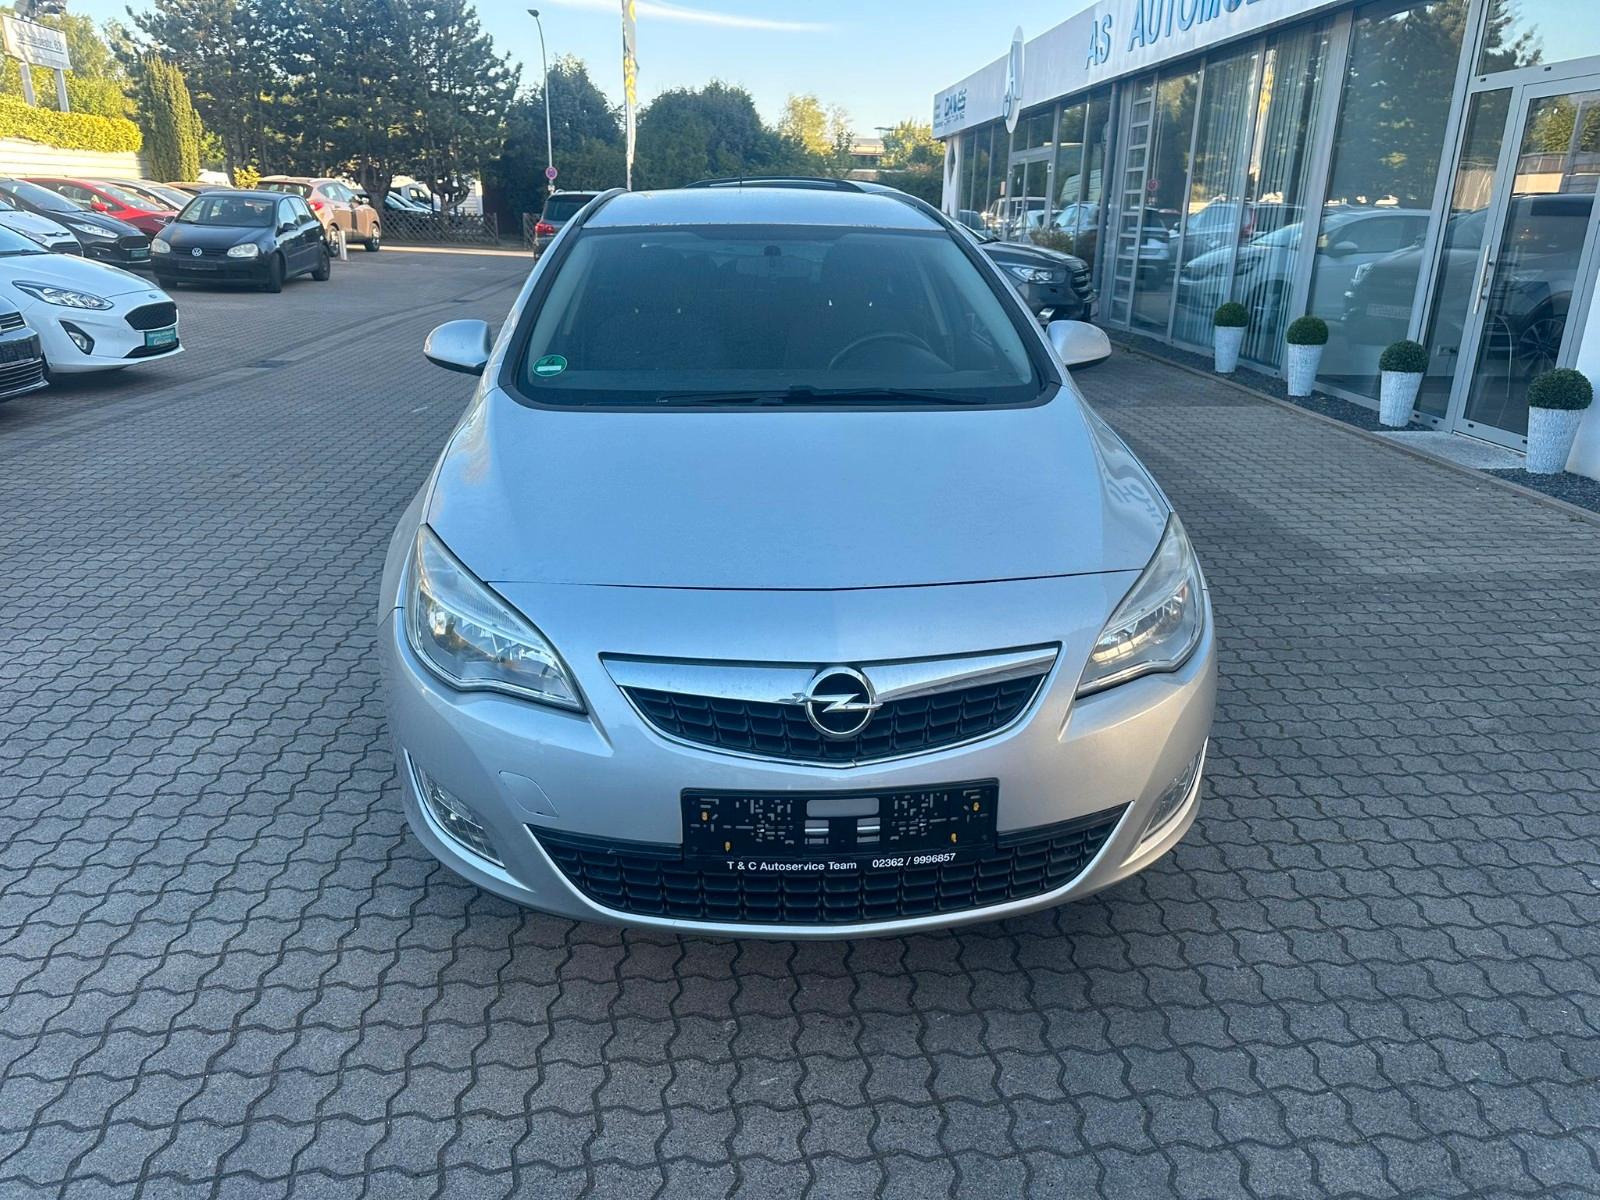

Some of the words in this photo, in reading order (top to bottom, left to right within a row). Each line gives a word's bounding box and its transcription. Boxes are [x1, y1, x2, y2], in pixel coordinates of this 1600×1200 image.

[1085, 13, 1112, 70] AS
[1127, 0, 1262, 52] AUTO
[727, 861, 735, 870] T
[737, 861, 746, 870] &
[748, 861, 757, 871] C
[759, 861, 825, 871] Autoservice
[828, 861, 857, 870] Team
[872, 857, 904, 868] 02362
[905, 856, 912, 866] /
[913, 852, 956, 865] 9996857
